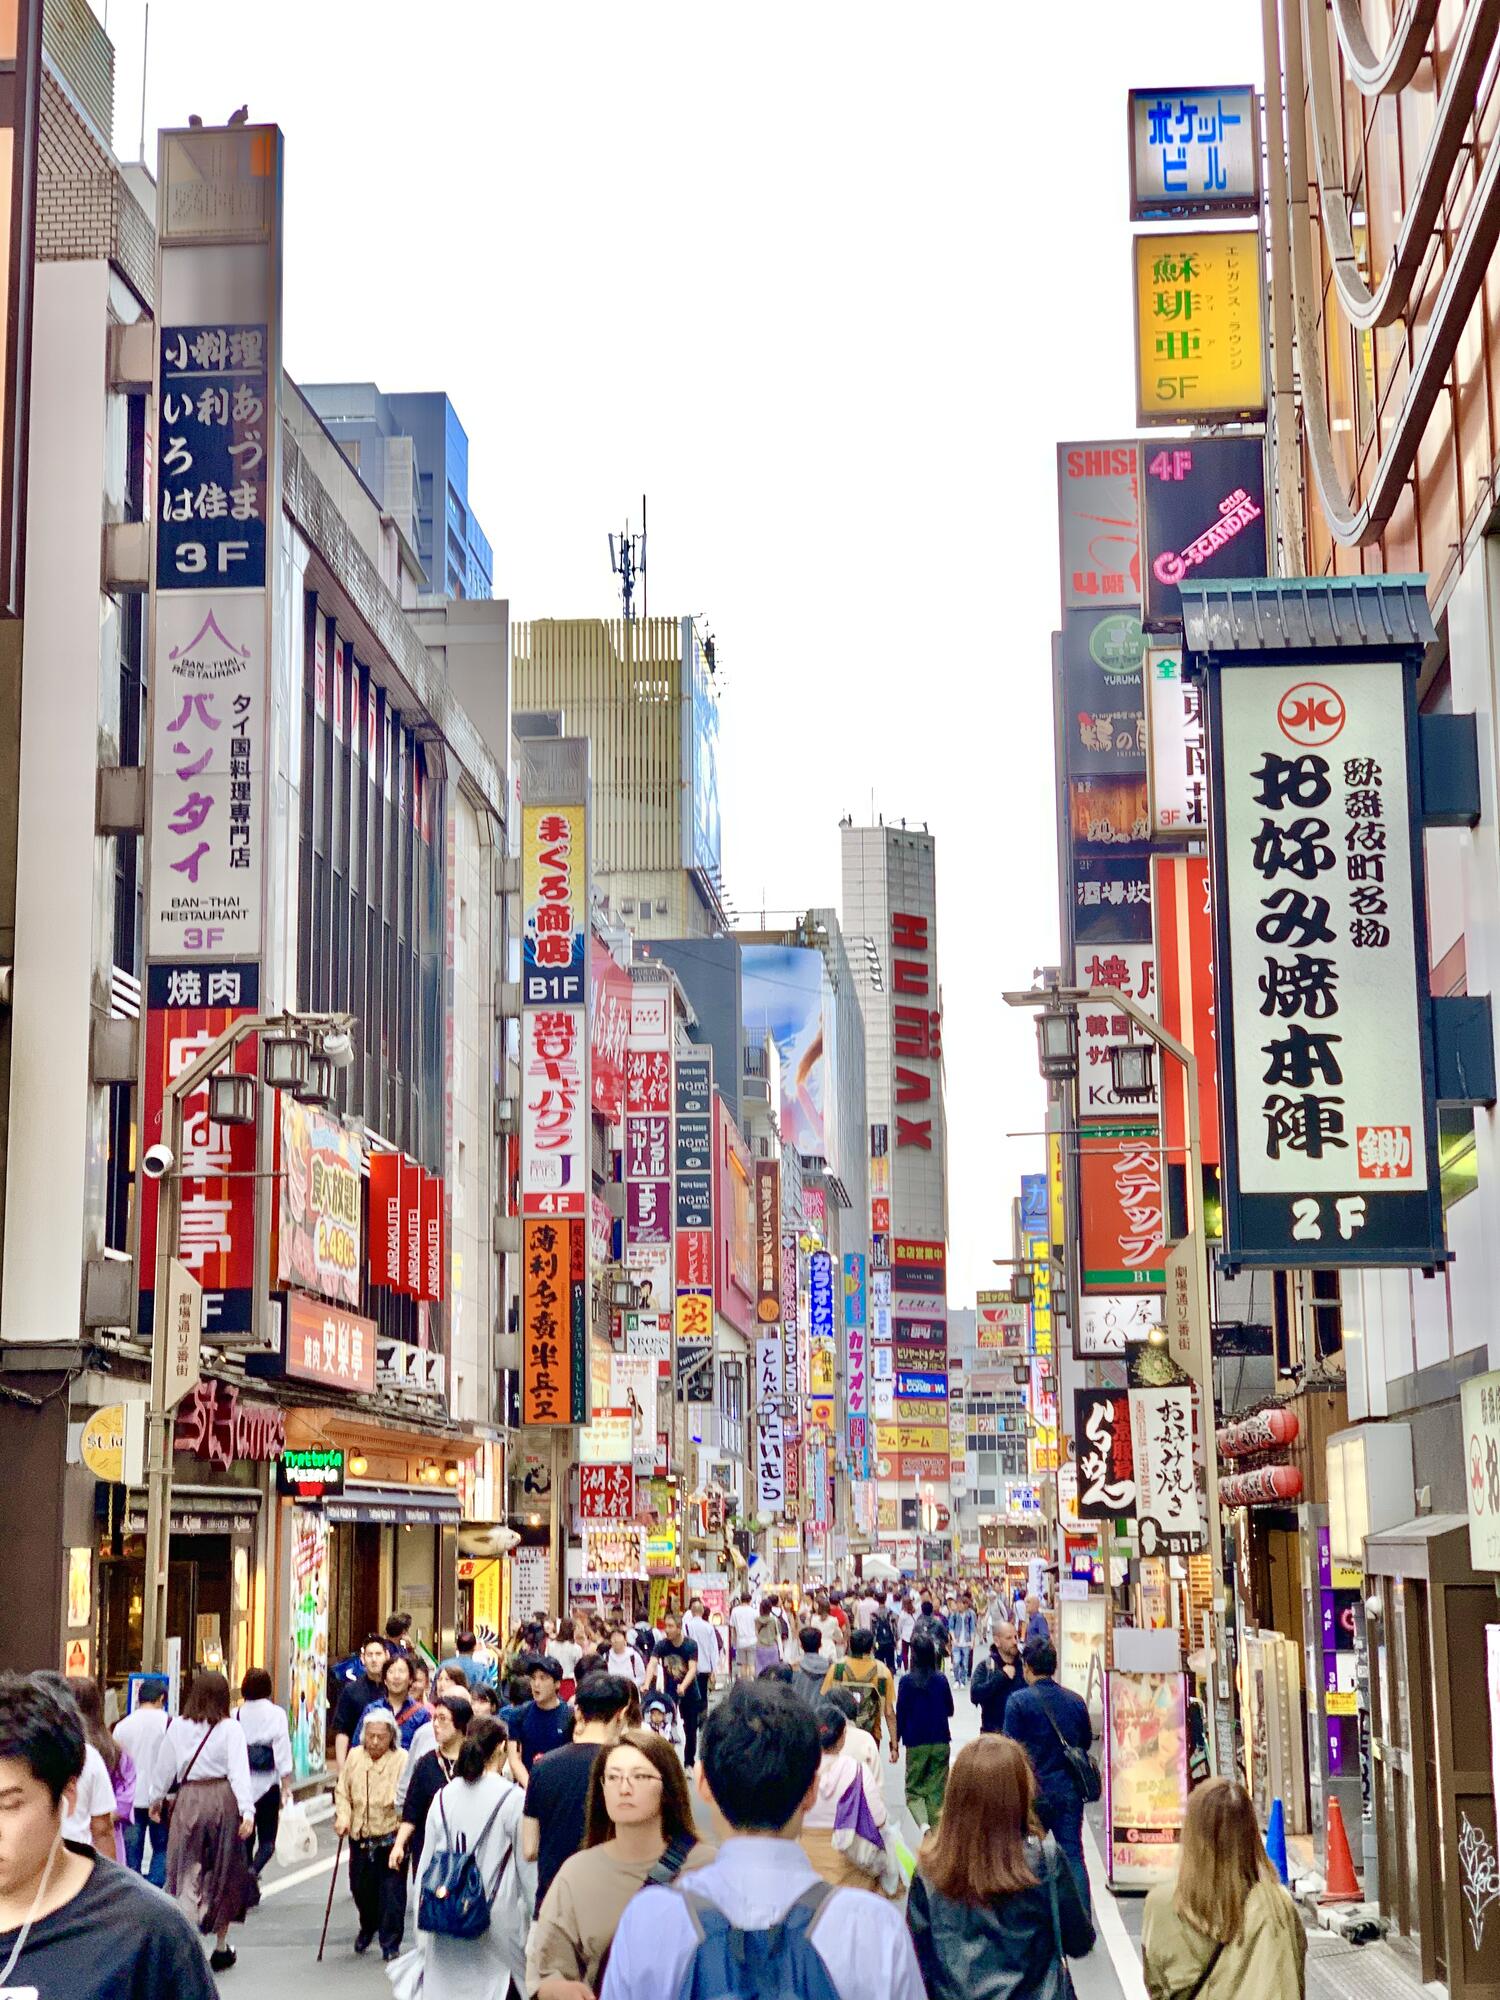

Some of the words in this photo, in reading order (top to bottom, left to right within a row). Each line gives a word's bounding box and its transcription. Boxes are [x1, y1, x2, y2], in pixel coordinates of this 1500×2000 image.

[1148, 99, 1241, 144] ポケット
[1162, 146, 1228, 193] ビル
[165, 329, 264, 371] 小料理
[1155, 375, 1200, 401] 5F
[162, 393, 195, 526] いろは
[227, 383, 264, 523] あづま
[1148, 450, 1192, 481] 4F
[165, 693, 222, 884] バンタイ
[229, 693, 253, 870] タイ国料理専門店
[1160, 808, 1181, 825] 3F
[1343, 756, 1390, 949] 歌舞伎町名物
[535, 813, 573, 969] まぐろ商店
[160, 910, 250, 922] RESTAURANT
[182, 928, 226, 951] 3F
[1249, 751, 1350, 1162] お好み焼本陣
[166, 969, 241, 1007] 焼肉
[528, 975, 580, 1001] B1F
[538, 1193, 571, 1214] 4F
[1113, 1141, 1166, 1268] ステップ
[813, 1254, 830, 1324] カラオケ
[1133, 1270, 1151, 1283] B1
[1174, 1266, 1191, 1351] 劇場通り一番街
[175, 1292, 192, 1377] 劇場通り一番街
[303, 1334, 321, 1370] 焼肉
[322, 1316, 364, 1382] 安楽亭
[849, 1330, 864, 1412] カラオケ
[284, 1450, 342, 1467] Trattoria
[1154, 1399, 1193, 1518] お好み焼き
[1168, 1536, 1201, 1553] B1F
[1323, 1608, 1333, 1632] 4F
[1330, 1736, 1338, 1759] B1
